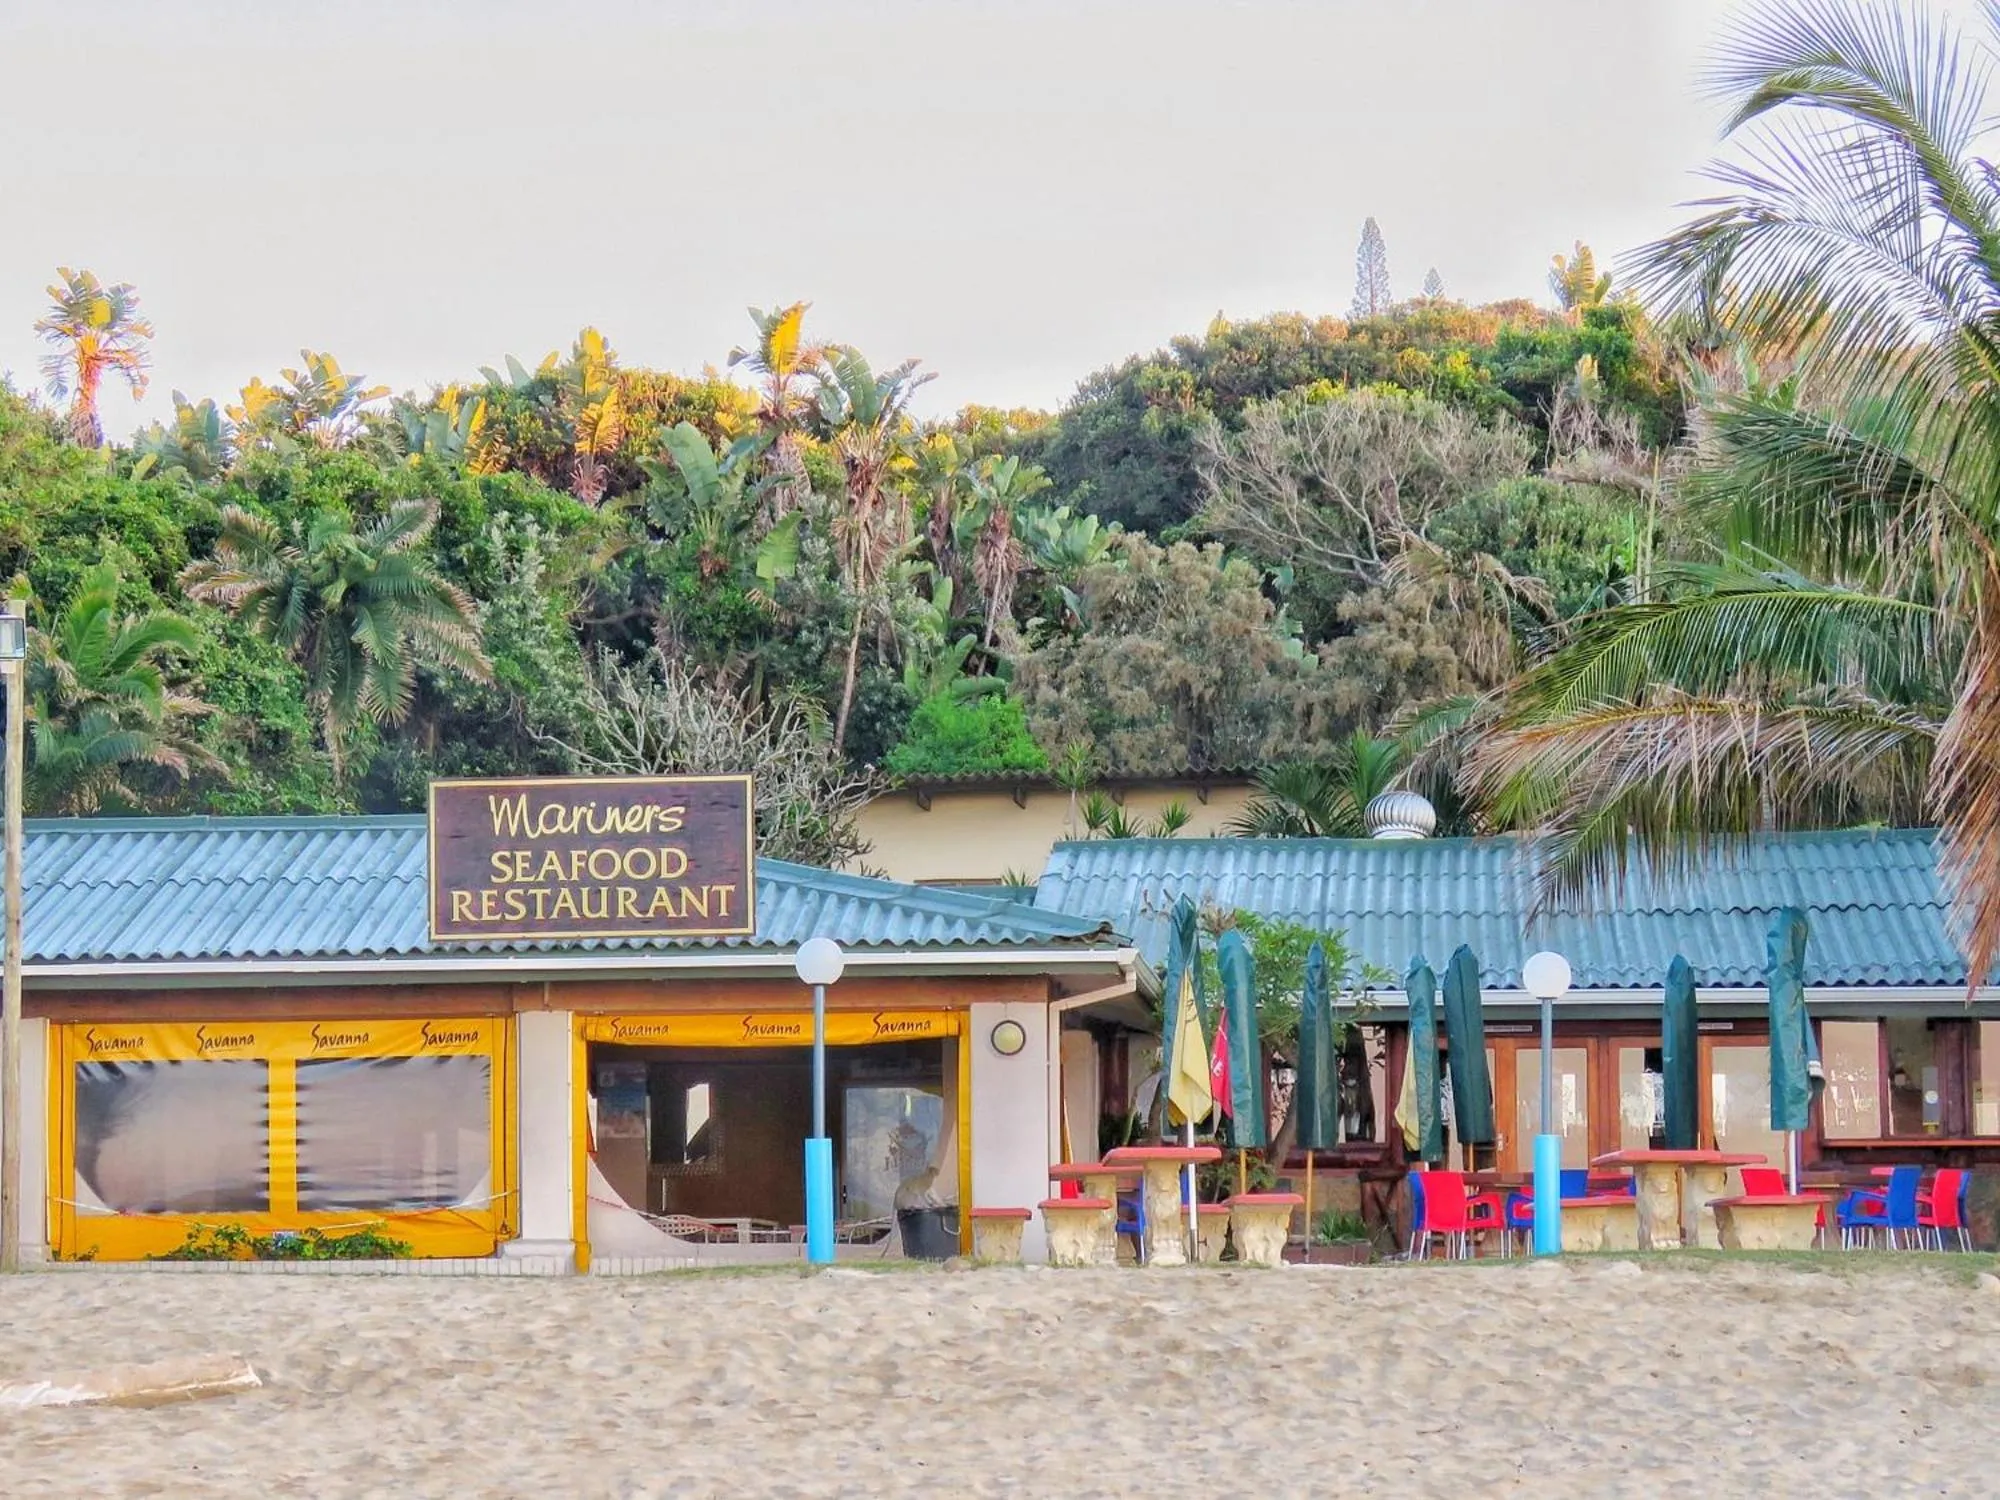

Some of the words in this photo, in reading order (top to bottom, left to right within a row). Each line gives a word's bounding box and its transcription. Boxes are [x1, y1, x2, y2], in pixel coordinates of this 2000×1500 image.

[488, 793, 686, 839] Mariners
[490, 847, 689, 883] SEAFOOD
[451, 884, 736, 922] RESTAURANT
[196, 1025, 255, 1055] Savanna
[311, 1023, 369, 1055] Savanna
[421, 1021, 479, 1051] Savanna
[611, 1017, 669, 1040] Savanna
[742, 1015, 801, 1040] Savanna
[873, 1012, 931, 1038] Savanna
[86, 1028, 144, 1055] Savanna
